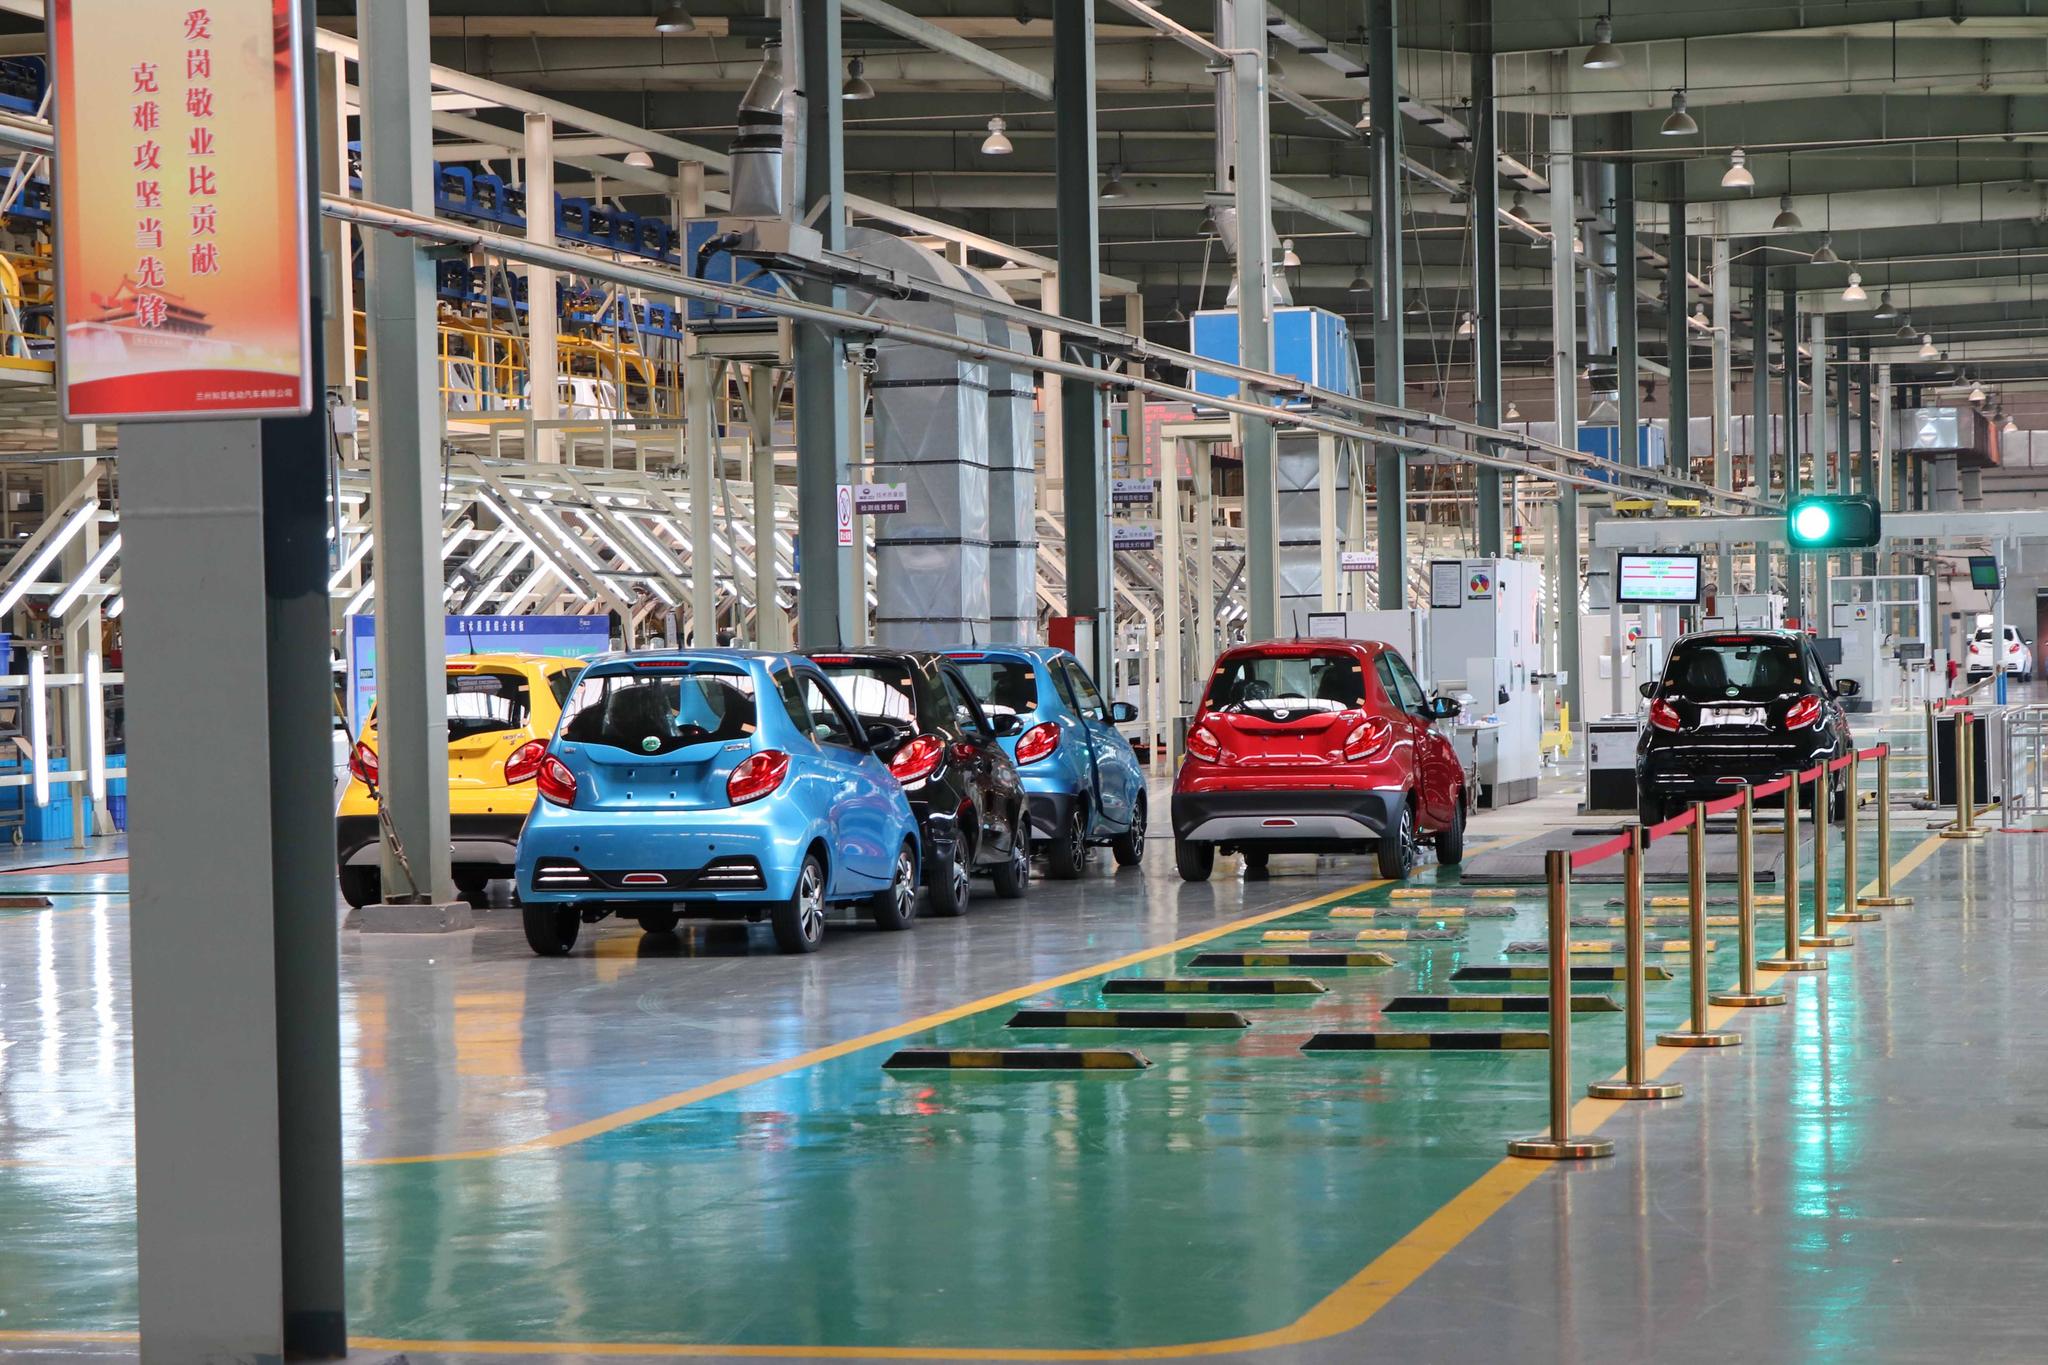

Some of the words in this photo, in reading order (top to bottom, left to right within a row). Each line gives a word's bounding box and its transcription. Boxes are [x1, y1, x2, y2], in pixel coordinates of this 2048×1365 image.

[131, 62, 166, 326] 克难攻坚当先锋
[184, 8, 218, 274] 爱岗敬业比贡献
